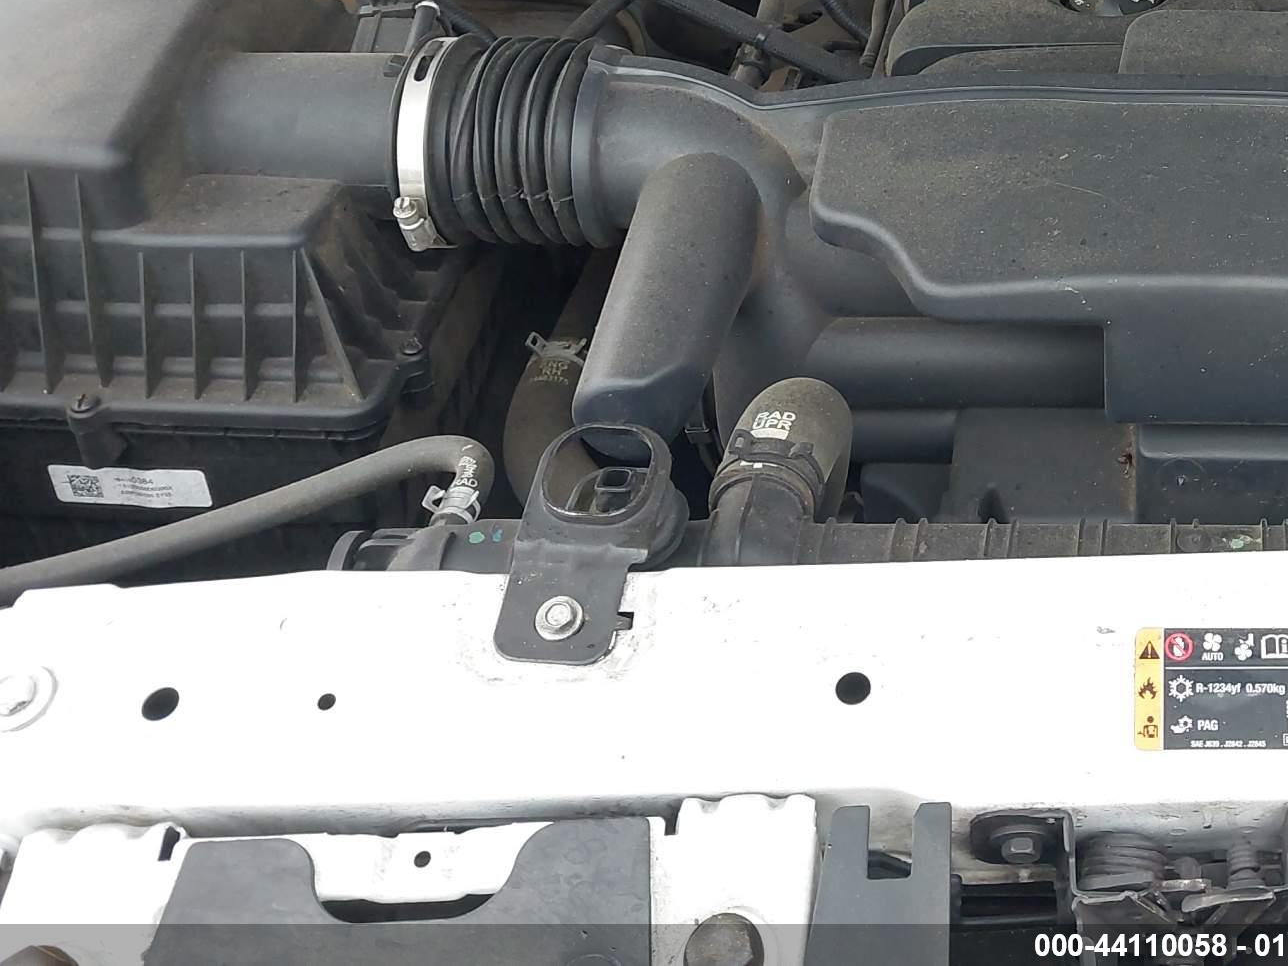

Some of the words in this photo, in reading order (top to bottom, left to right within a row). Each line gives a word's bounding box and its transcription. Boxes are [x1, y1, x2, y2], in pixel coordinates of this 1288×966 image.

[755, 410, 796, 422] RAD
[751, 418, 793, 431] UPR
[1201, 651, 1224, 662] AUTO
[1195, 682, 1241, 697] R-1234yf
[1245, 682, 1286, 697] 0.570kg
[1197, 719, 1219, 731] PAG
